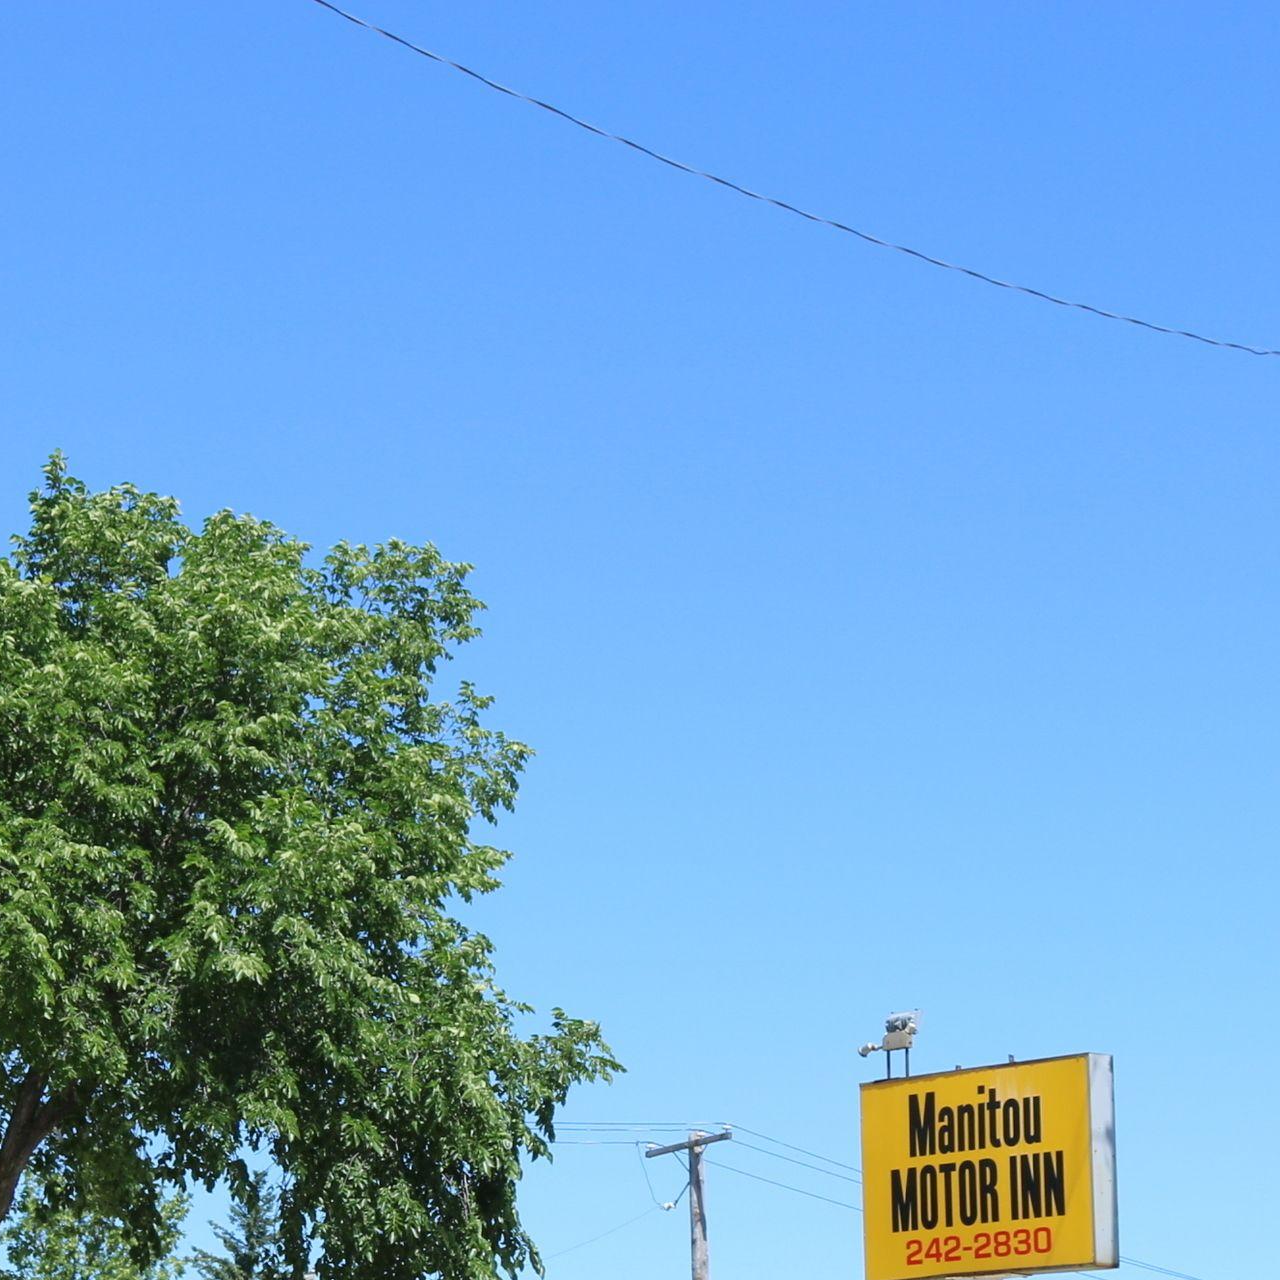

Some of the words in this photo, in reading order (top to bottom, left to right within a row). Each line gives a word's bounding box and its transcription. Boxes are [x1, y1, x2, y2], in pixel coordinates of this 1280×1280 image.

[908, 1085, 1041, 1157] Manitou
[890, 1158, 999, 1233] MOTOR
[1009, 1150, 1065, 1220] INN
[906, 1227, 1052, 1265] 242-2830
